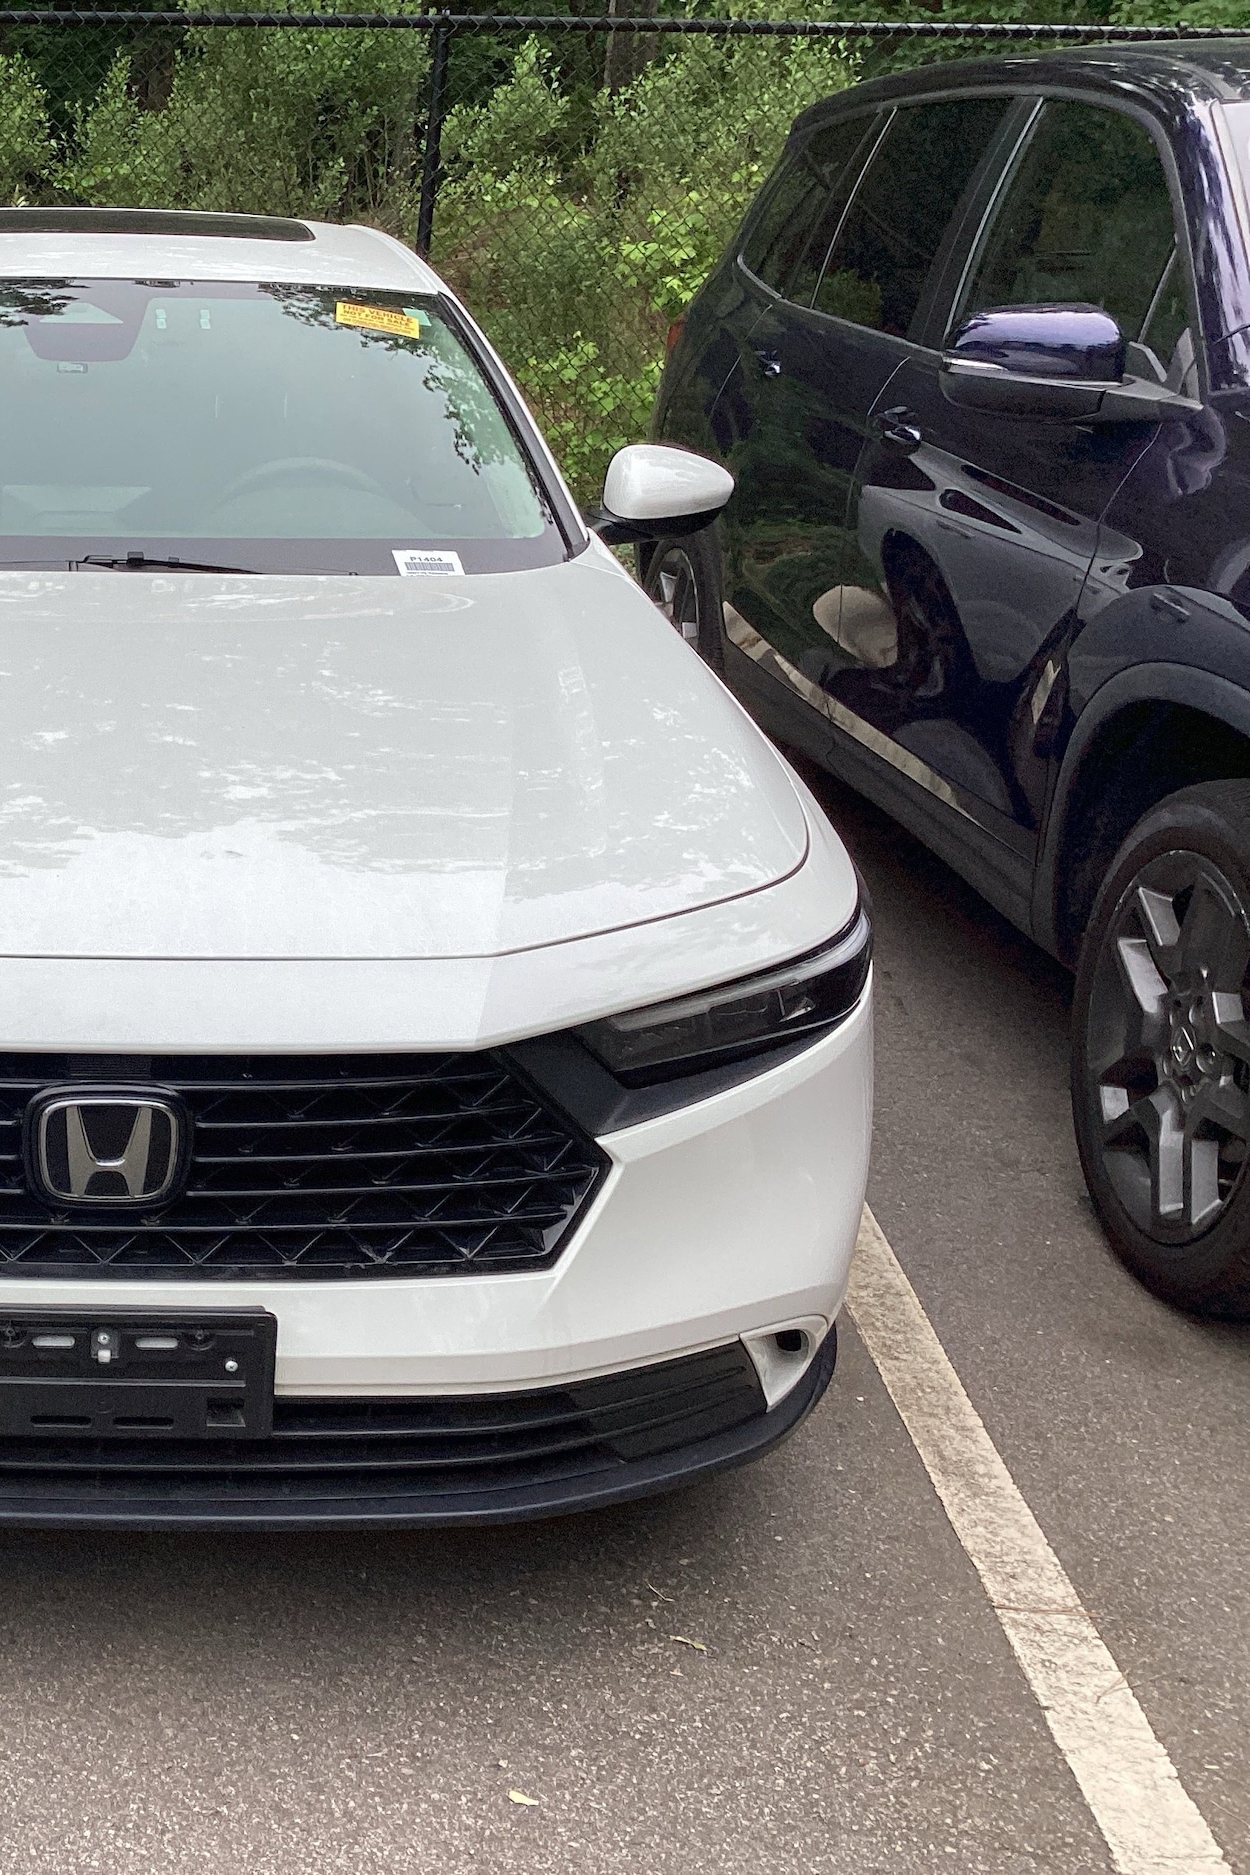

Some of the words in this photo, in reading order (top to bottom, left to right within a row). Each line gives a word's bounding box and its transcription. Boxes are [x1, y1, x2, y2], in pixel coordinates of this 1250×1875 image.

[342, 304, 365, 313] THIS
[368, 308, 413, 324] VEHICLE
[365, 313, 385, 321] FOR
[387, 318, 411, 327] SALE
